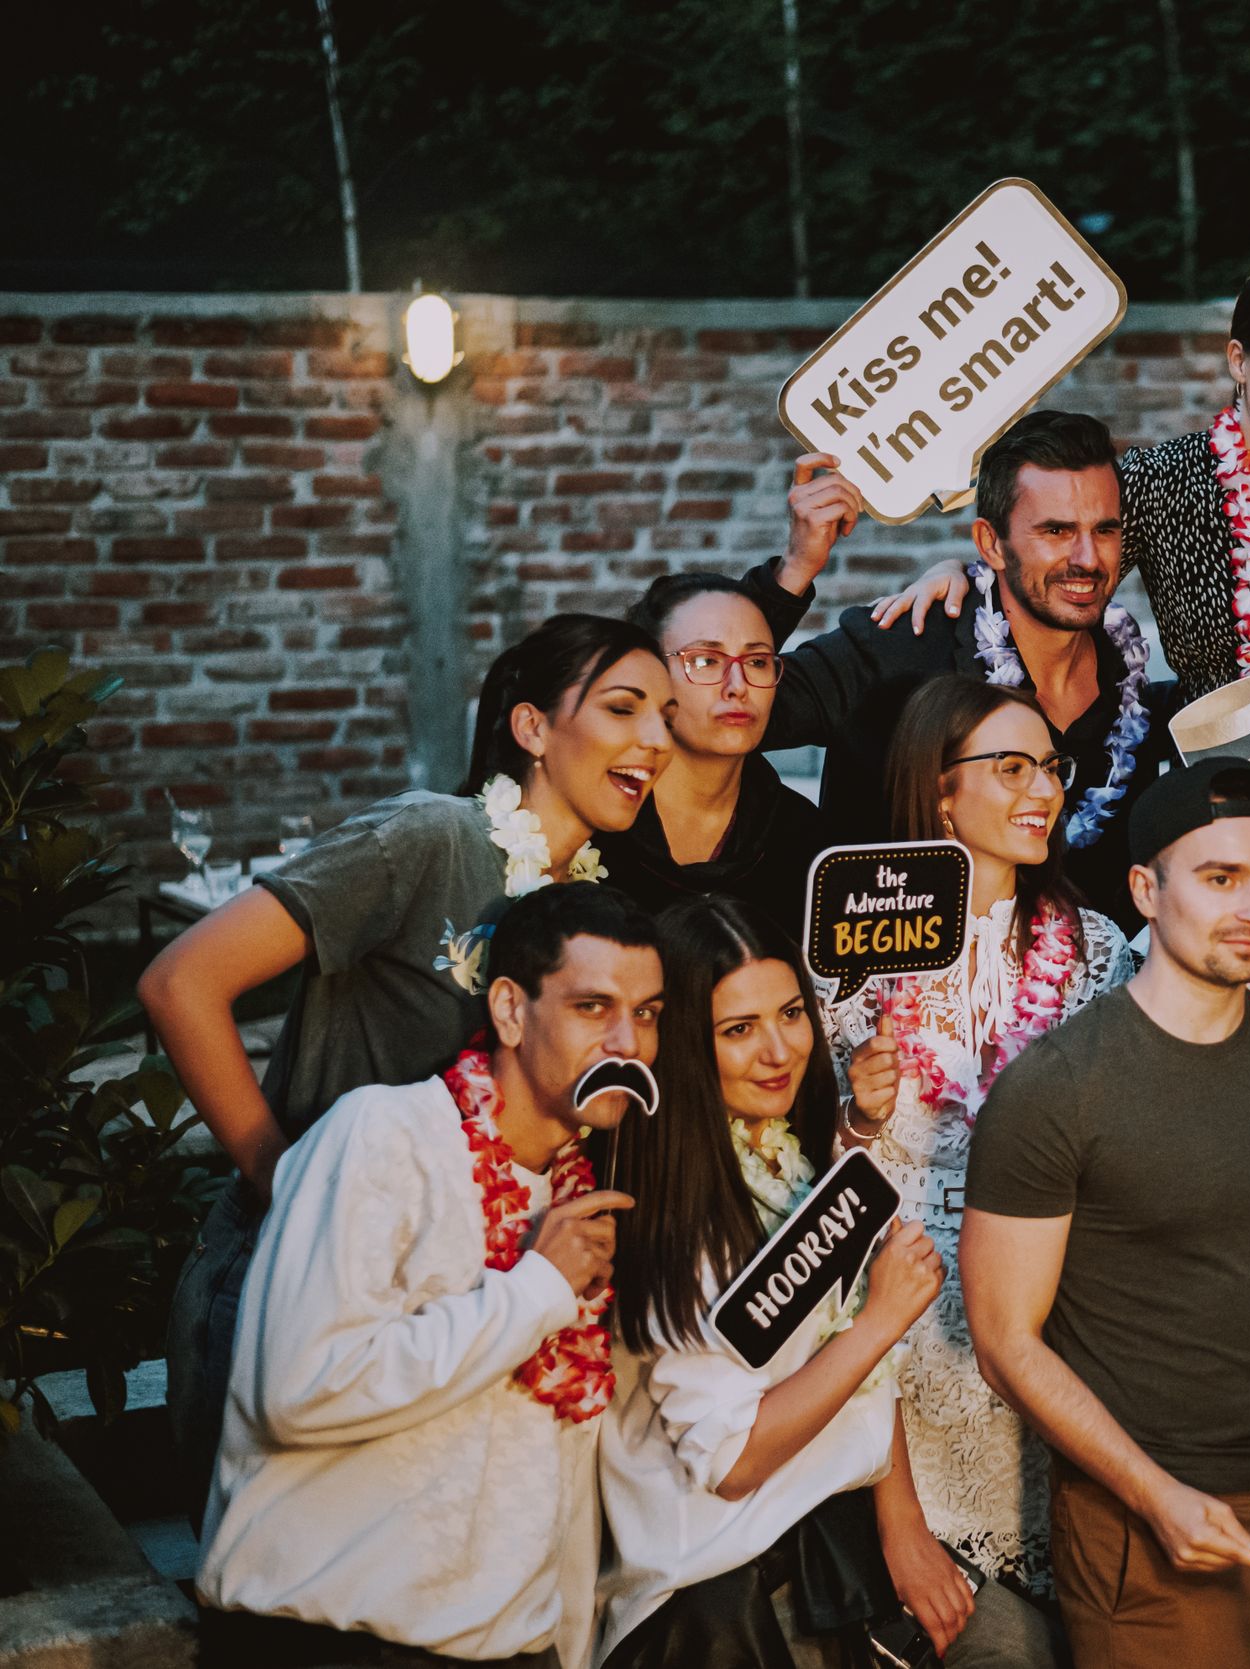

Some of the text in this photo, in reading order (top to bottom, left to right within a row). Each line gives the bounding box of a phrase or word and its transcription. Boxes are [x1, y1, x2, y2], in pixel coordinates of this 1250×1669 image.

[810, 240, 1012, 436] Kiss me!
[856, 260, 1086, 483] I'm smart!
[844, 887, 935, 915] Adventure
[876, 864, 908, 888] the
[832, 915, 943, 956] BEGINS
[745, 1187, 867, 1329] HOORAY!
